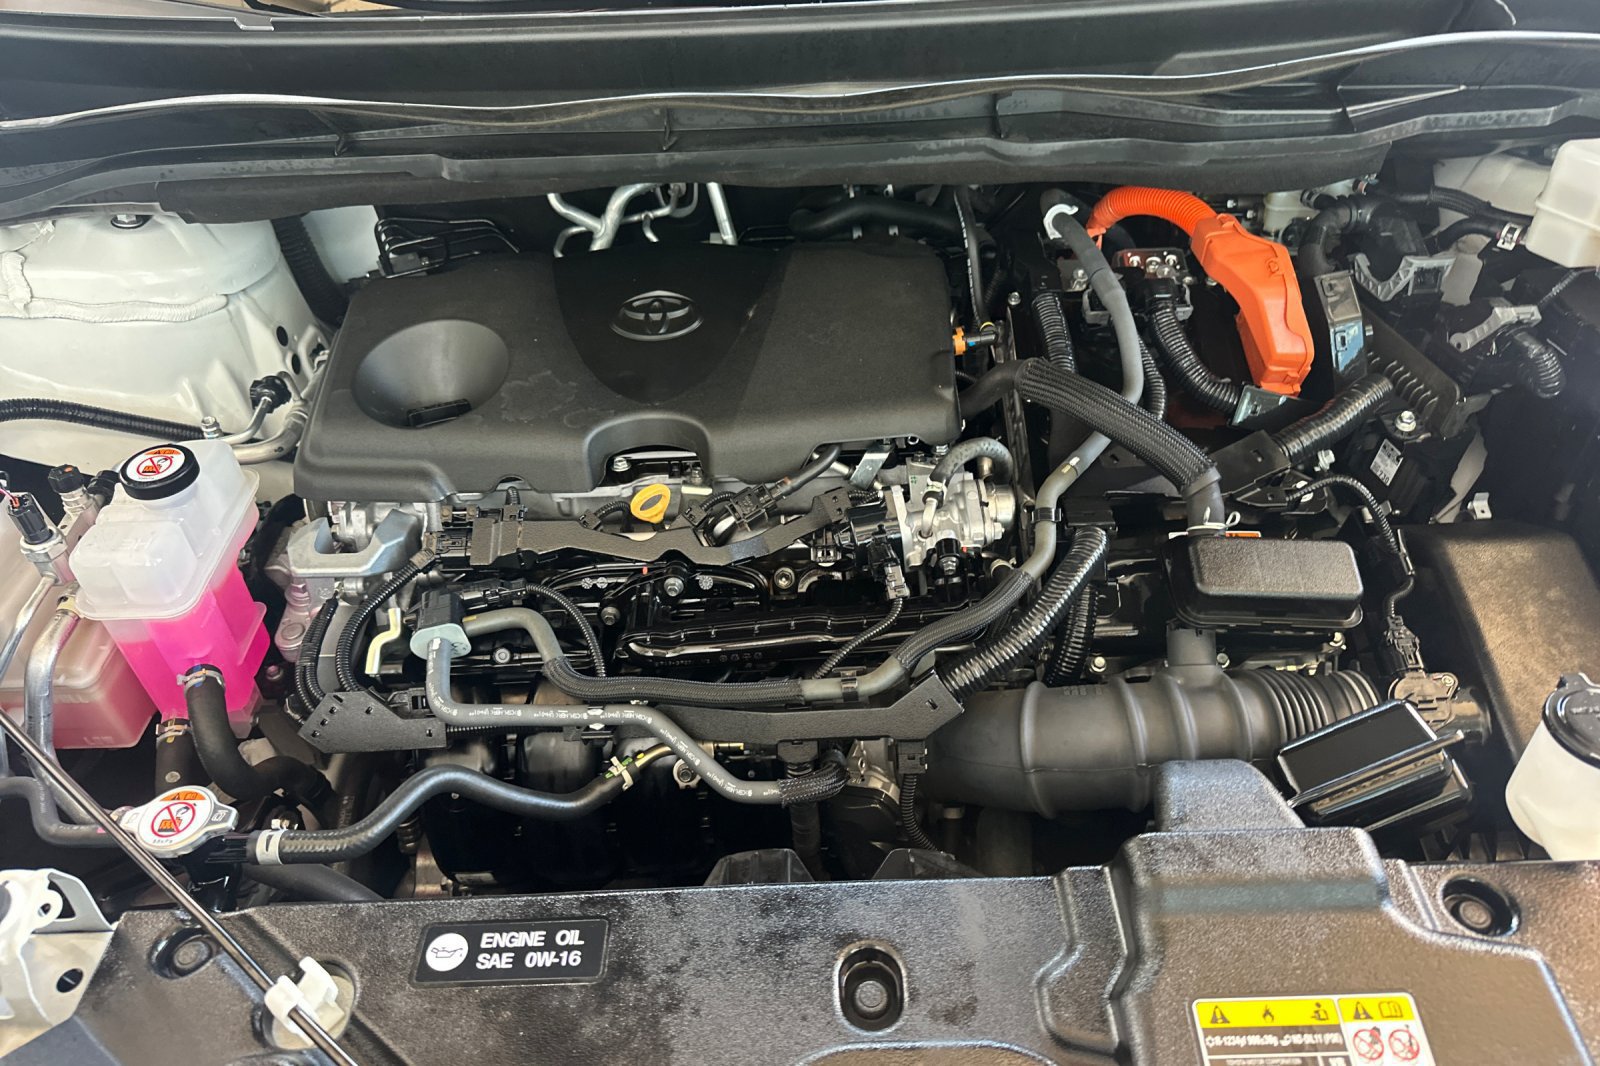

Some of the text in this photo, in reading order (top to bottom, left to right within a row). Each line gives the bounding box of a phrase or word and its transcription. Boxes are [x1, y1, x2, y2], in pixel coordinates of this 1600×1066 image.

[480, 930, 585, 948] ENGINE OIL
[475, 950, 582, 969] SAE 0W-16
